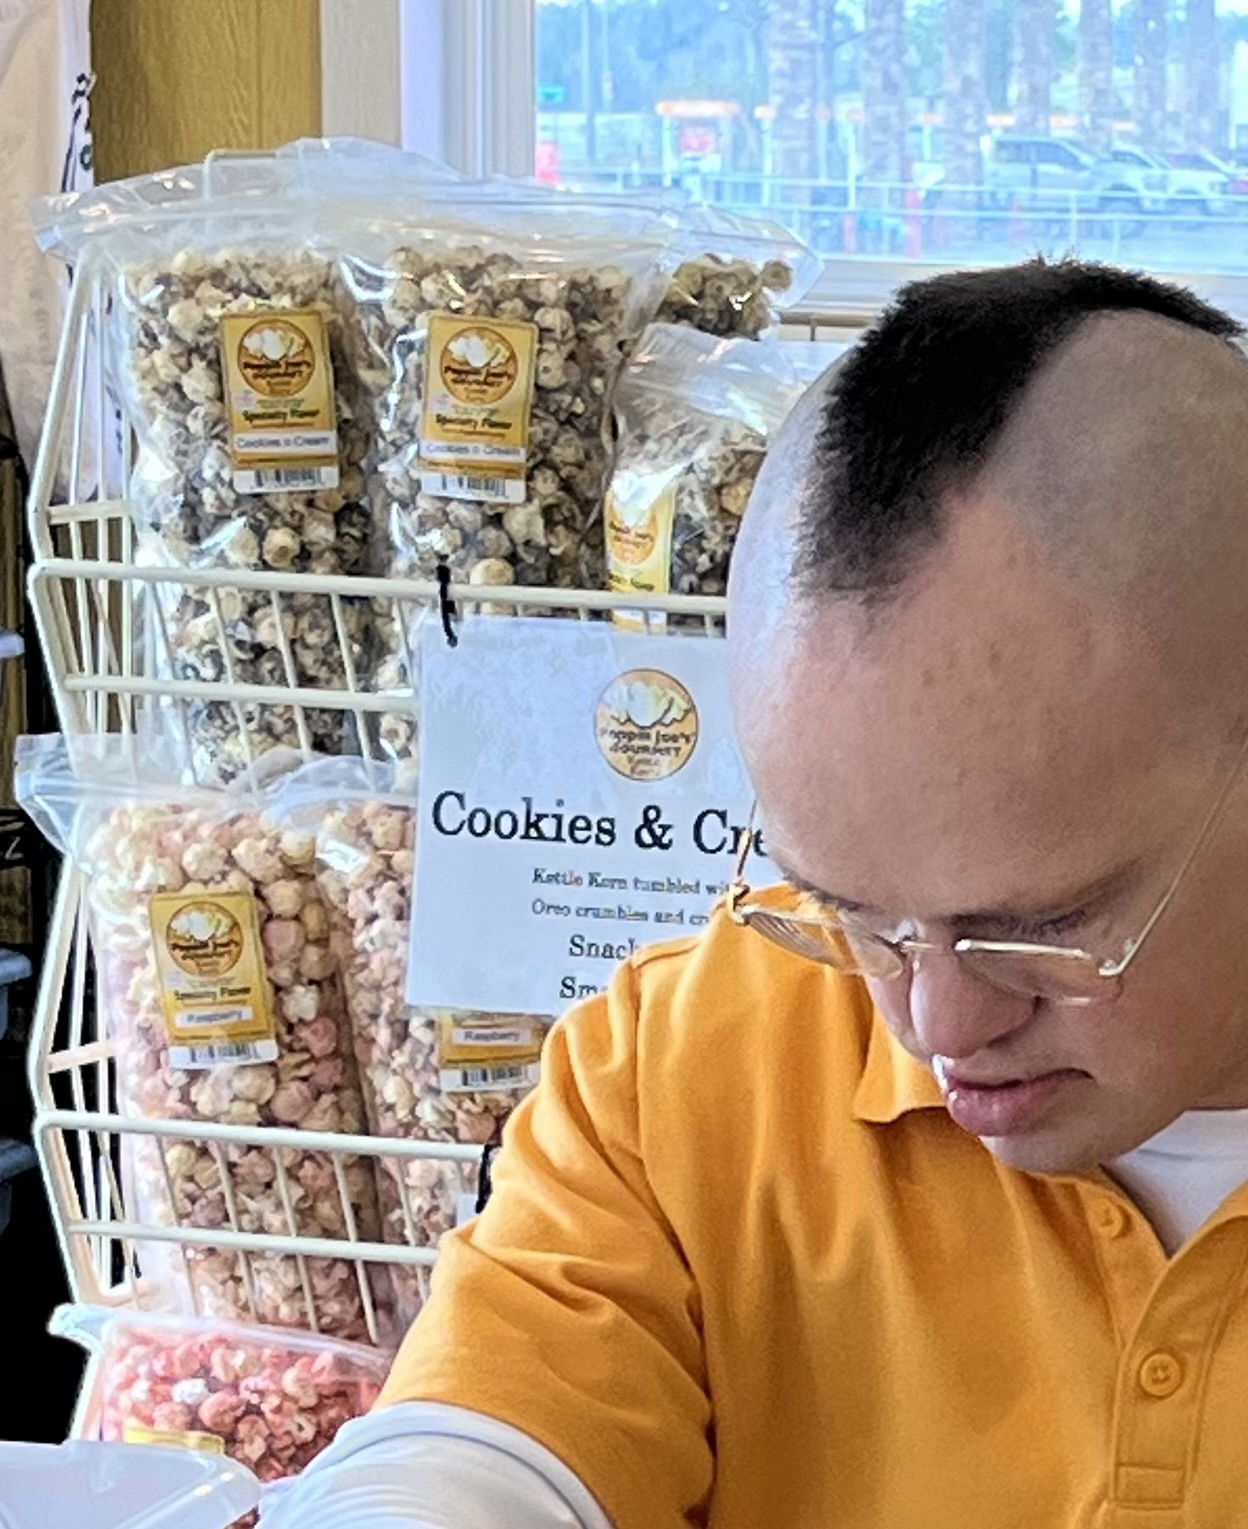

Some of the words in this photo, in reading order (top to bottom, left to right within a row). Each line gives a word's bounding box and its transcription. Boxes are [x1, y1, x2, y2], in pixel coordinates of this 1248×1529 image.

[237, 436, 281, 449] Cookies
[294, 435, 329, 447] Cream
[431, 790, 616, 847] Cookies
[634, 804, 674, 851] &
[692, 808, 768, 857] Cre
[532, 867, 583, 886] Kettle
[588, 871, 628, 890] Korn
[632, 876, 701, 894] tumbled
[705, 880, 730, 896] wi
[532, 898, 571, 917] Oreo
[575, 904, 649, 921] crumbles
[654, 907, 685, 925] and
[689, 913, 709, 926] cr
[559, 975, 608, 1000] Sm
[187, 1010, 243, 1023] Raspberry
[463, 1030, 521, 1042] Raspberry
